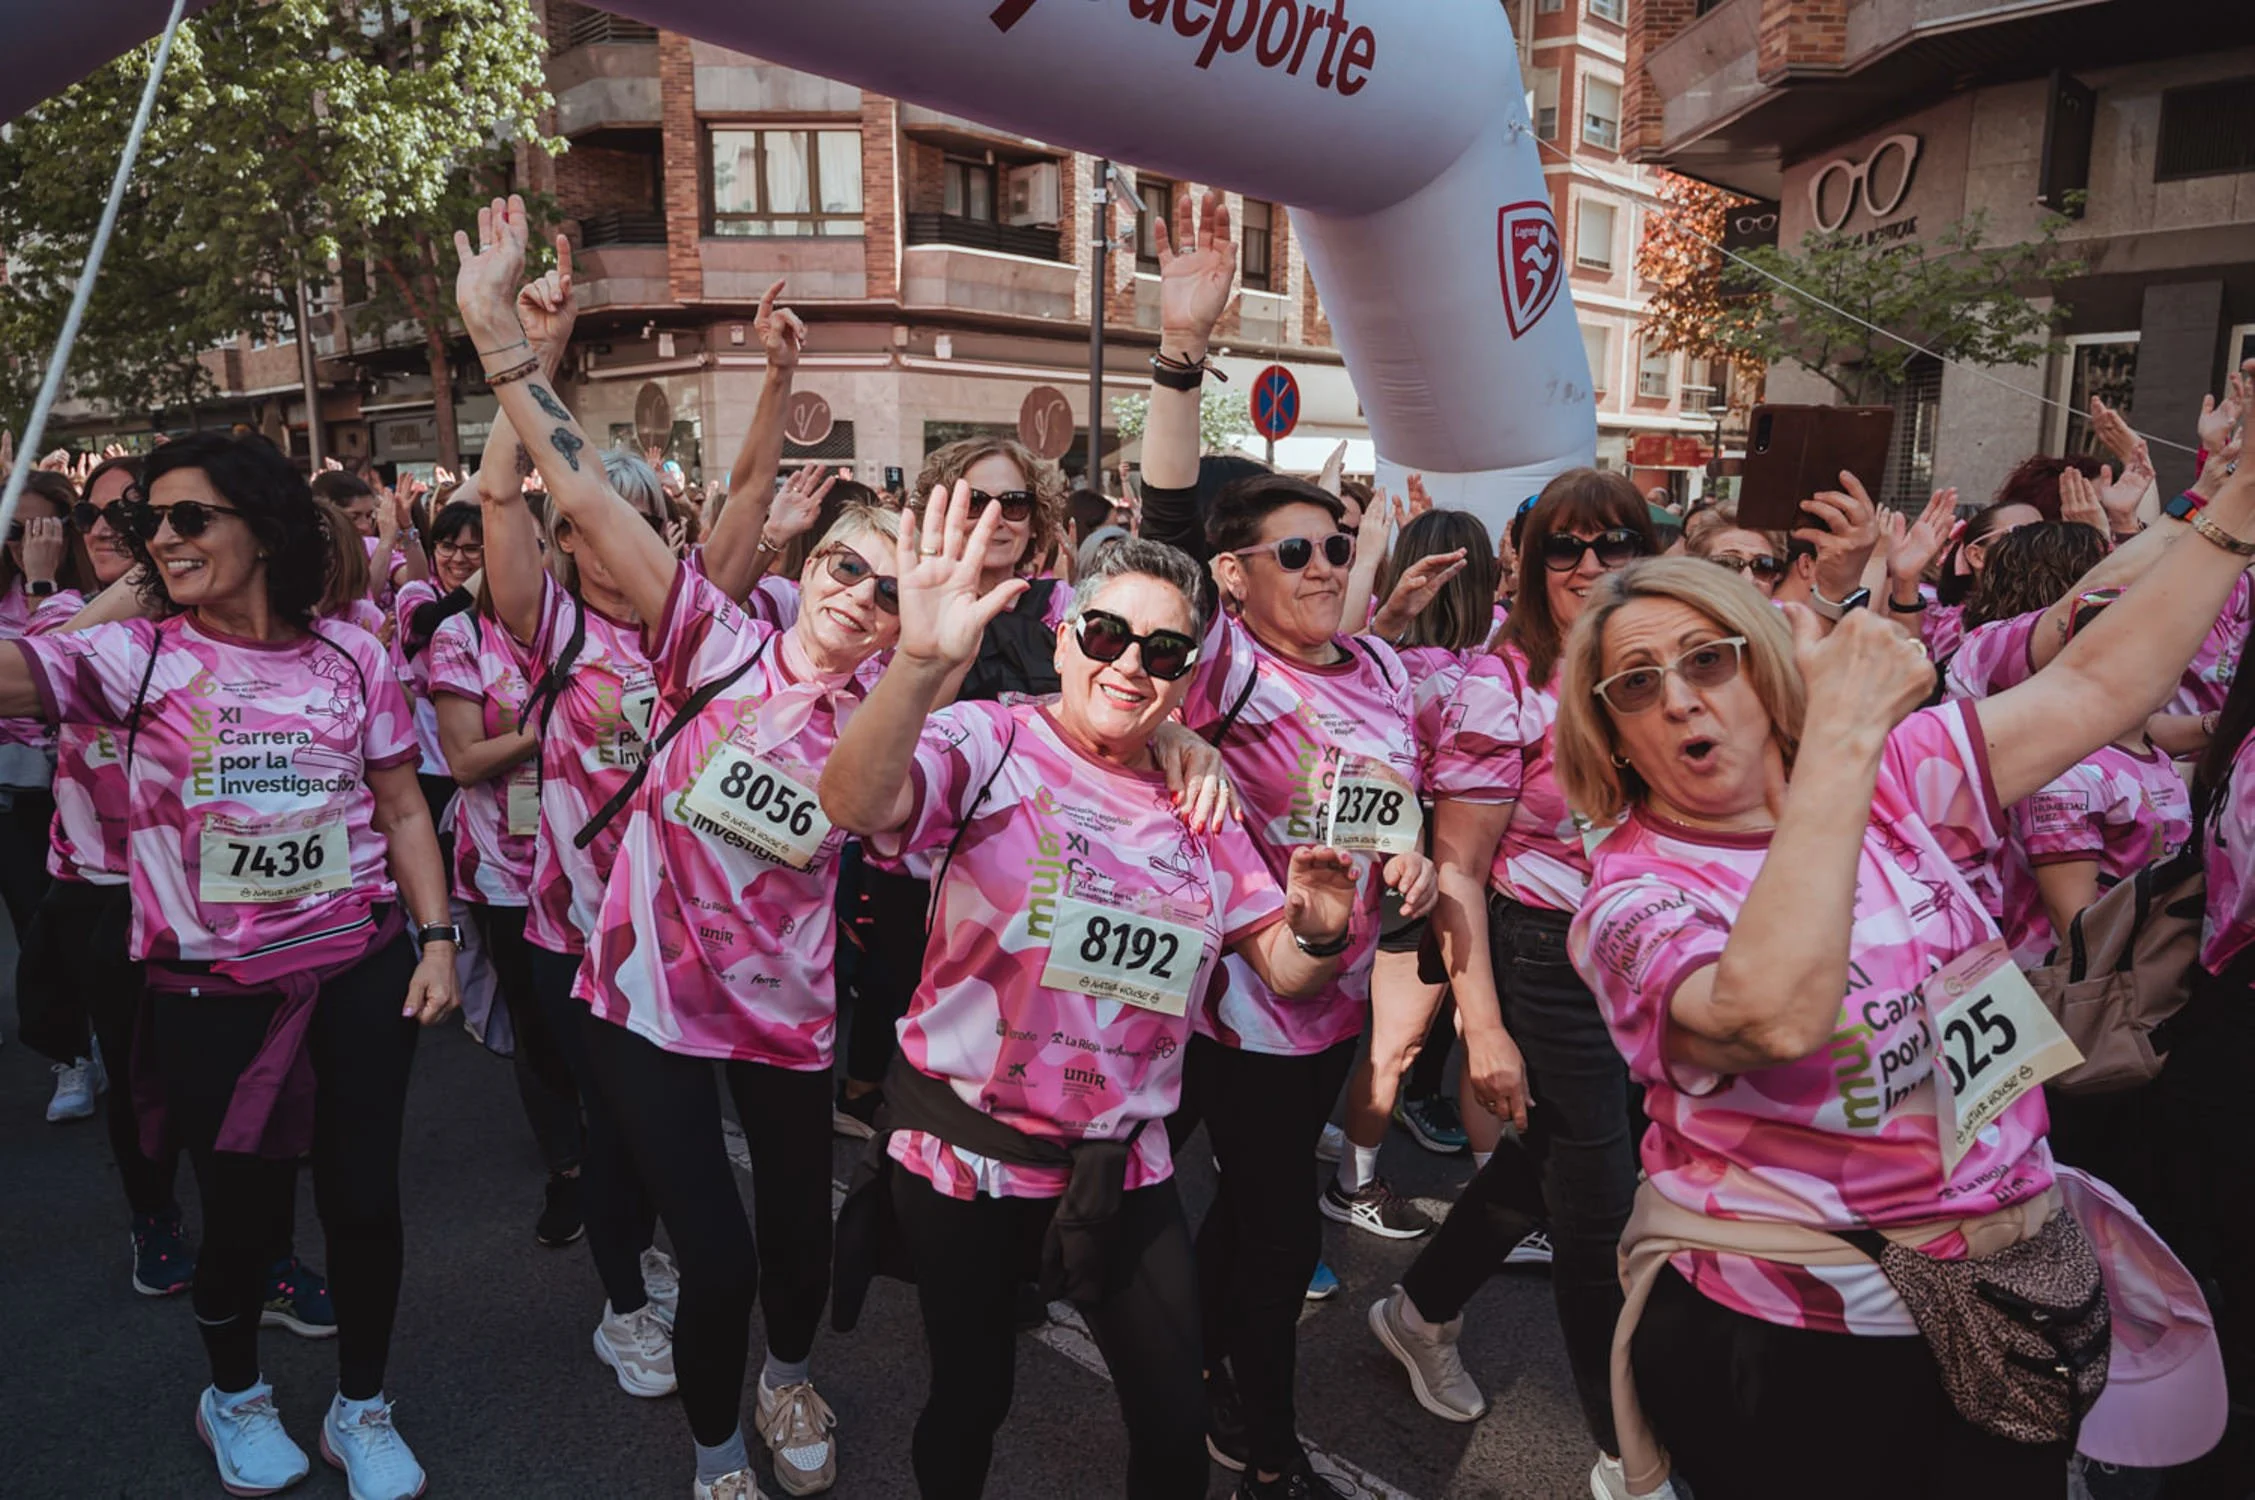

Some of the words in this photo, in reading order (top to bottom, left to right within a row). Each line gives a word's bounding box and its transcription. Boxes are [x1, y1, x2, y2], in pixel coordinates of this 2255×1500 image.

[1128, 0, 1377, 97] eporte
[218, 707, 241, 724] XI
[192, 704, 221, 796] mujer
[218, 729, 311, 745] Carrera
[619, 730, 641, 746] po
[1322, 745, 1342, 765] XI
[220, 755, 261, 774] por
[266, 751, 288, 769] la
[720, 761, 817, 836] 8056
[1286, 736, 1322, 838] mujer
[1335, 785, 1404, 826] 2378
[228, 834, 324, 878] 7436
[1066, 831, 1089, 856] XI
[1080, 915, 1179, 980] 8192
[1065, 1035, 1077, 1047] La
[1880, 1032, 1919, 1084] por
[1829, 1005, 1881, 1129] muj
